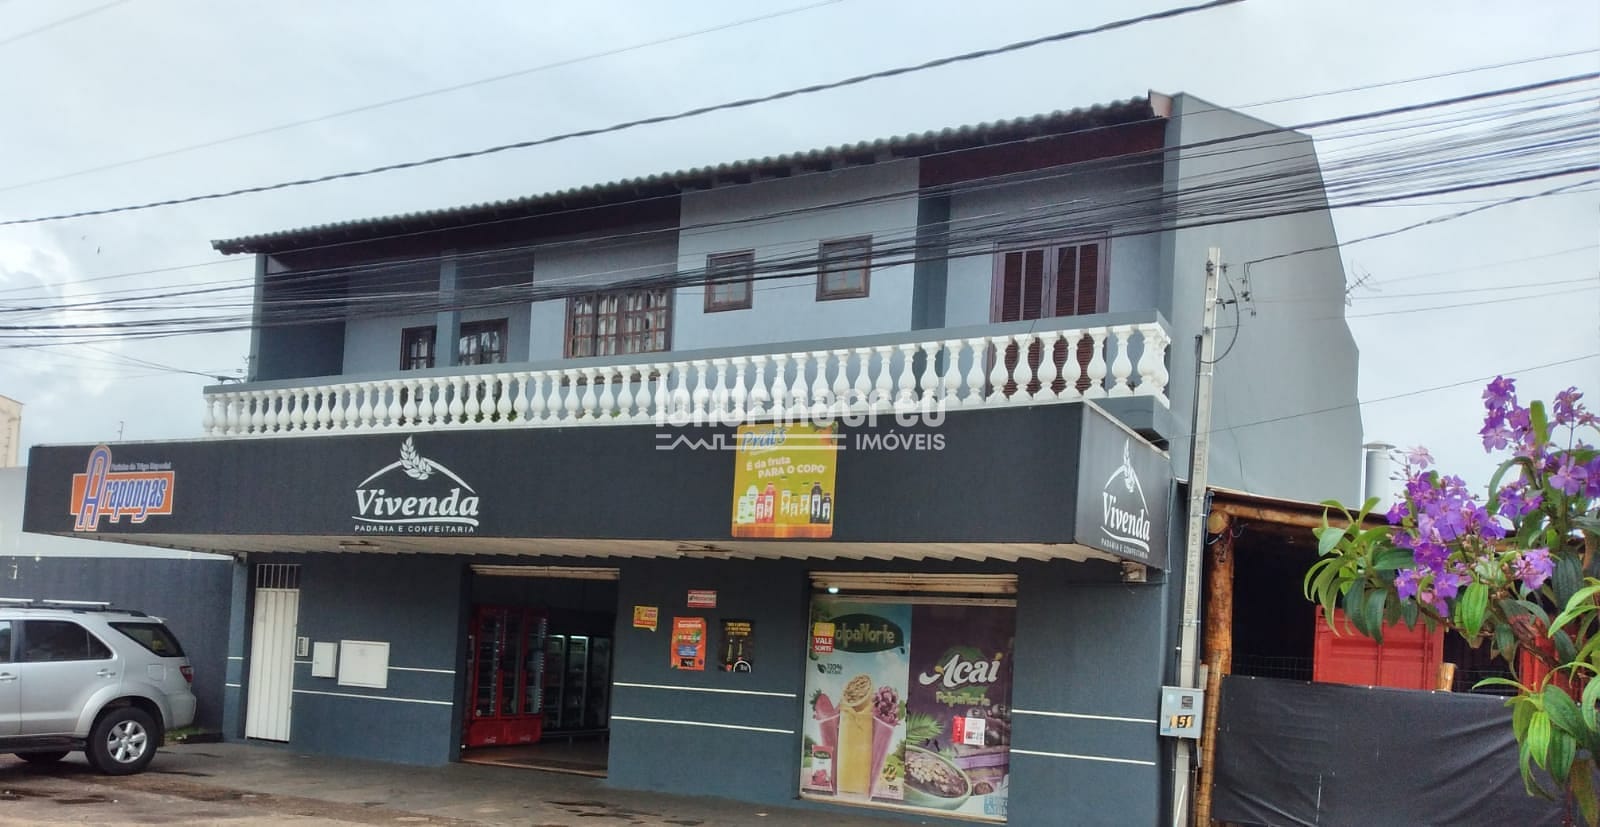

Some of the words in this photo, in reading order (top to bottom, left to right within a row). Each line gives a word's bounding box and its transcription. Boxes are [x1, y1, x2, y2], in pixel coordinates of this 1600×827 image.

[754, 459, 767, 470] da
[767, 456, 792, 468] fruta
[758, 466, 785, 478] PARA
[786, 465, 795, 475] O
[796, 463, 826, 475] COPO
[75, 445, 168, 531] Arapongas
[356, 487, 480, 516] Vivenda
[1102, 491, 1151, 542] Vivenda
[354, 524, 395, 533] PADARIA
[407, 525, 475, 533] CONFEITARIA
[815, 637, 833, 645] VALE
